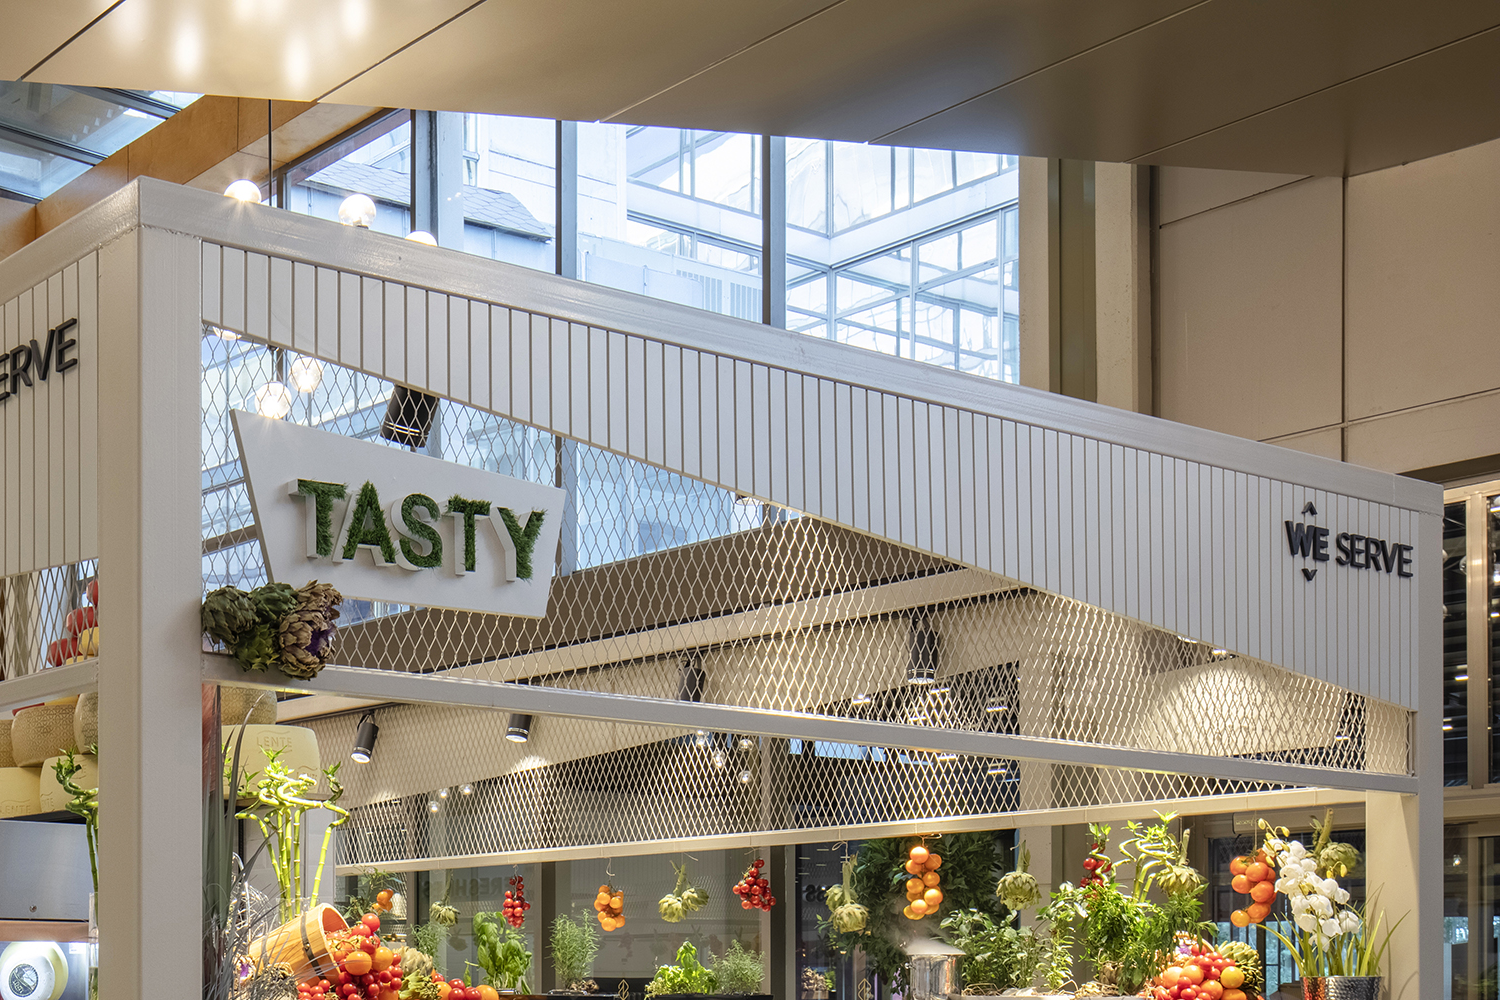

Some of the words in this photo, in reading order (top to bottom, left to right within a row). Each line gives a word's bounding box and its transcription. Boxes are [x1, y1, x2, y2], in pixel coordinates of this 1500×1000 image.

[288, 478, 547, 582] TASTY
[1285, 520, 1329, 562] WE
[1336, 532, 1413, 578] SERVE
